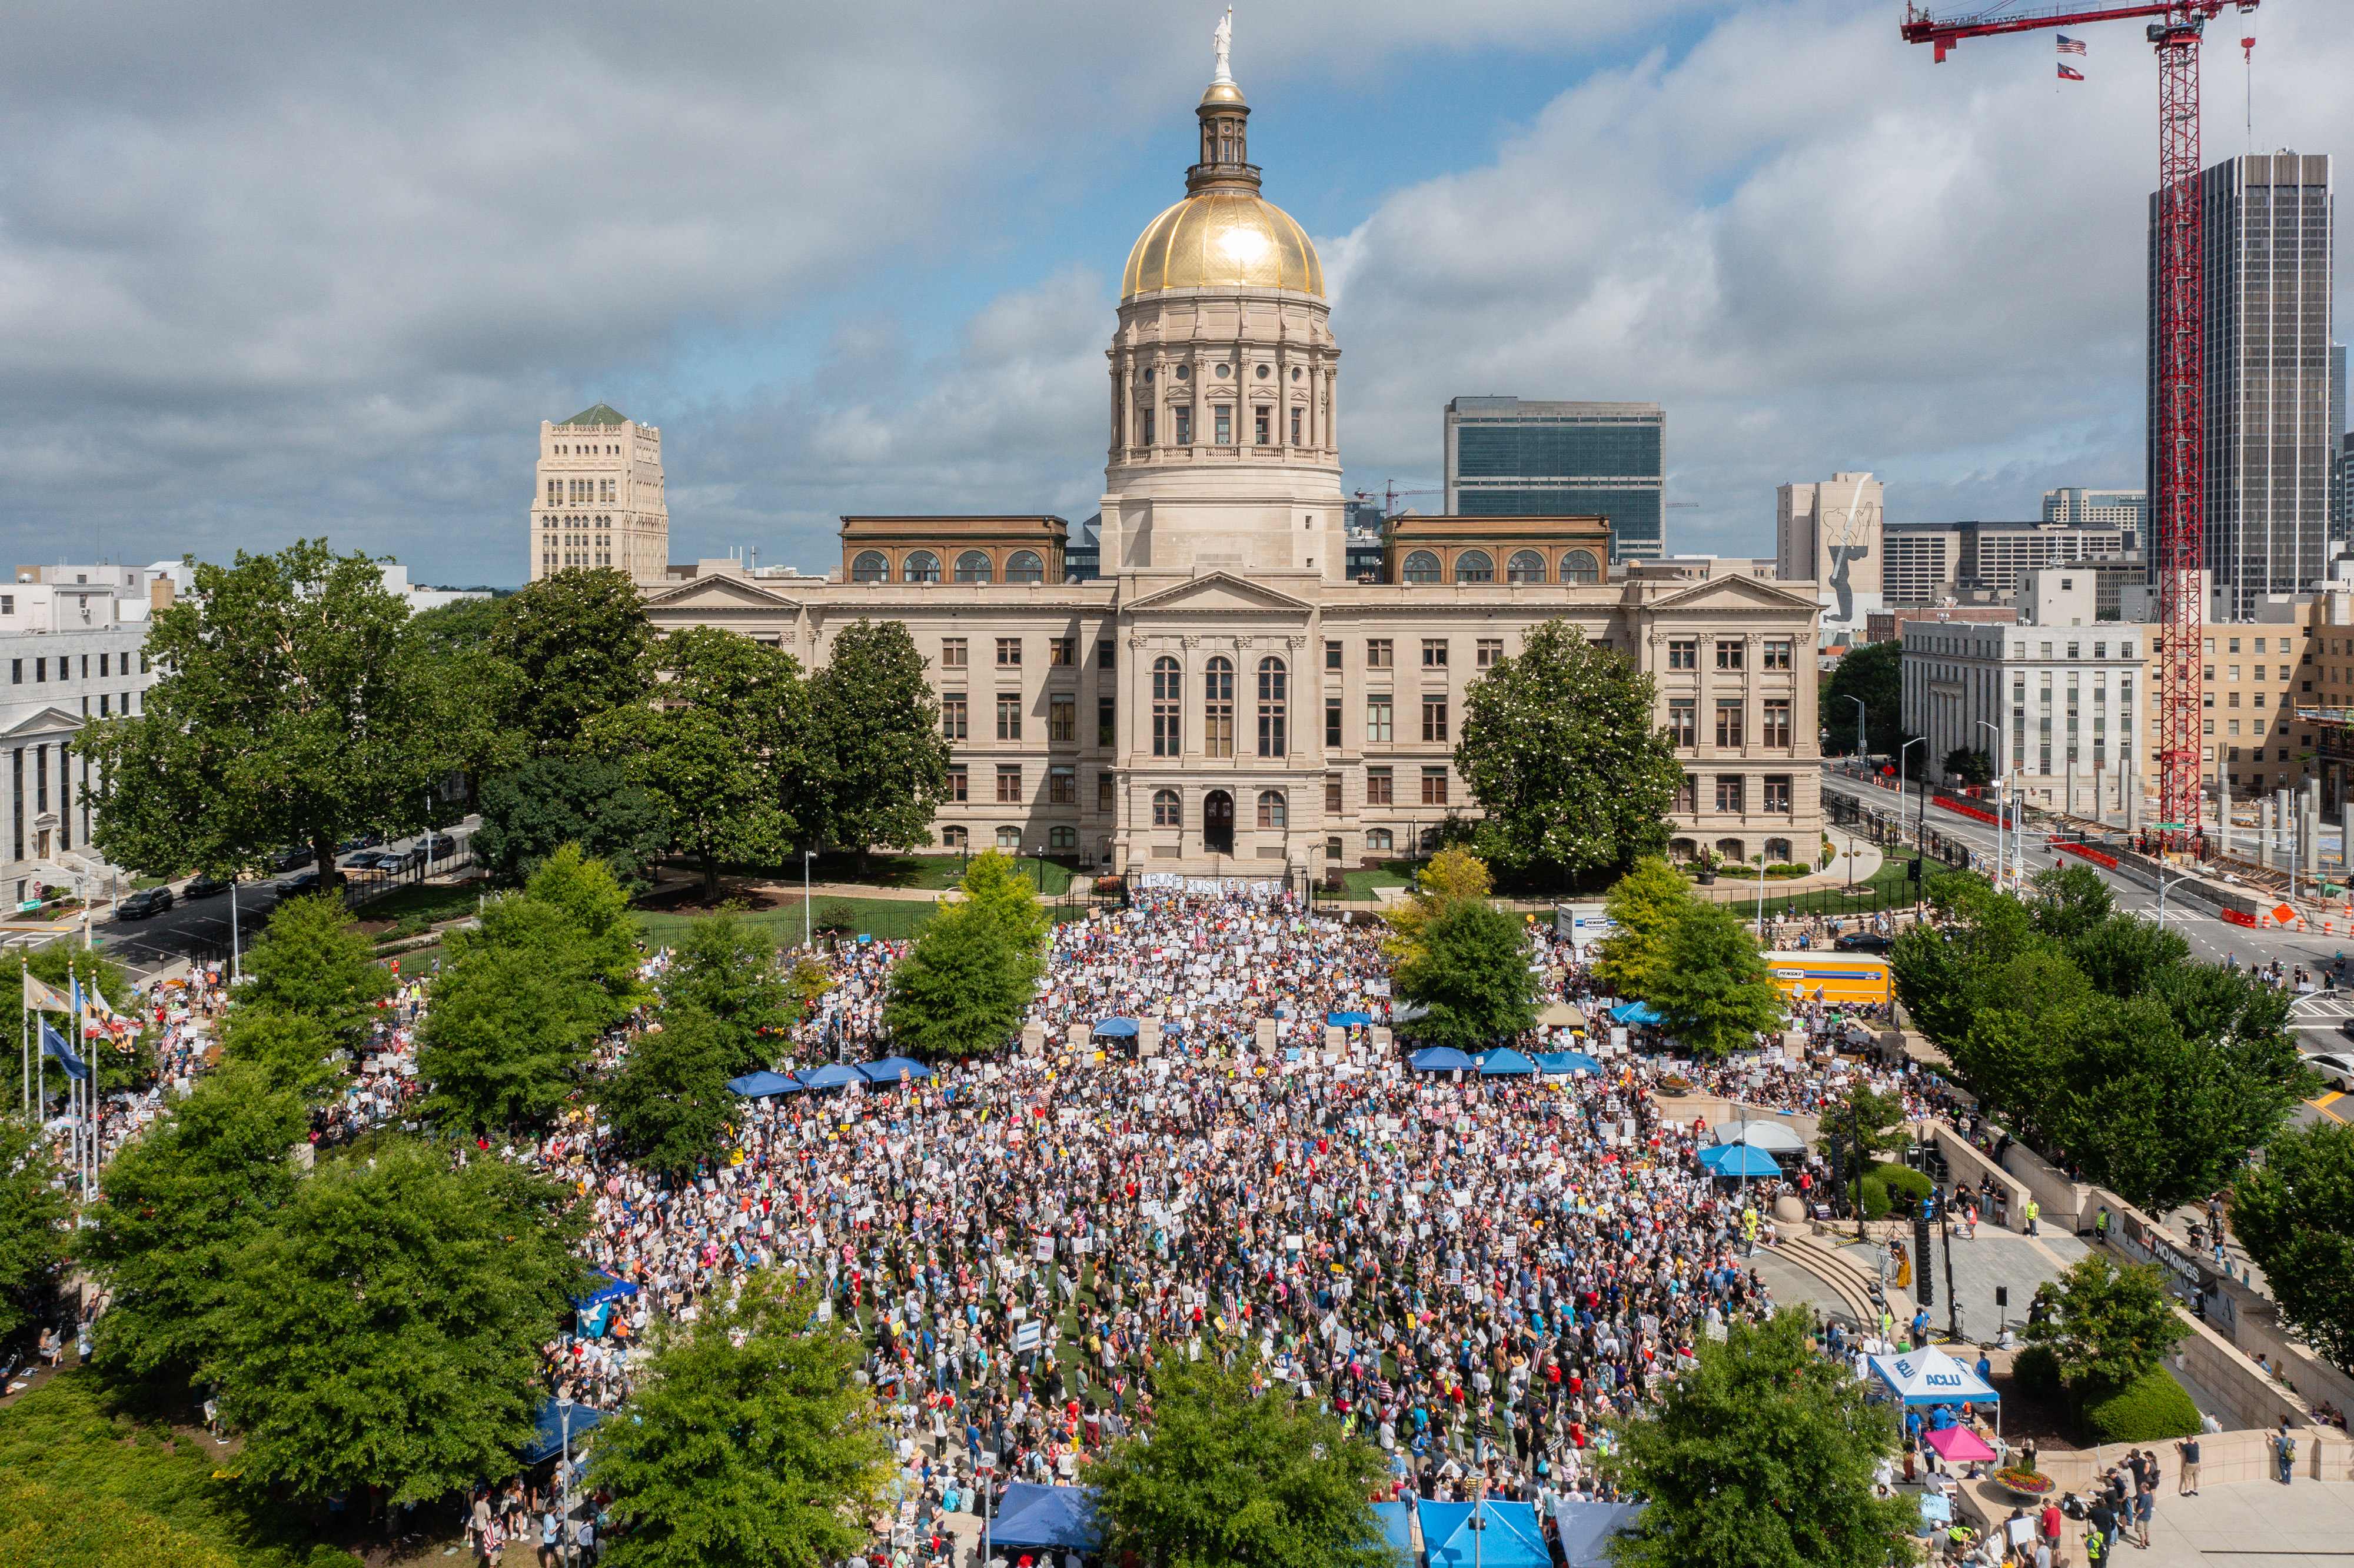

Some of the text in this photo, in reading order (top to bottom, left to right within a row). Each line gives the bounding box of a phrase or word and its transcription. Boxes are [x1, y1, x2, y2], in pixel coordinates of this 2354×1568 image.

[1143, 874, 1182, 888] TRUMP
[1187, 880, 1220, 894] MUST
[1226, 878, 1246, 893] GO
[1062, 1217, 1071, 1226] NO
[2154, 1240, 2200, 1283] NO KINGS
[1893, 1359, 1916, 1379] ACLU
[1926, 1374, 1961, 1386] ACLU
